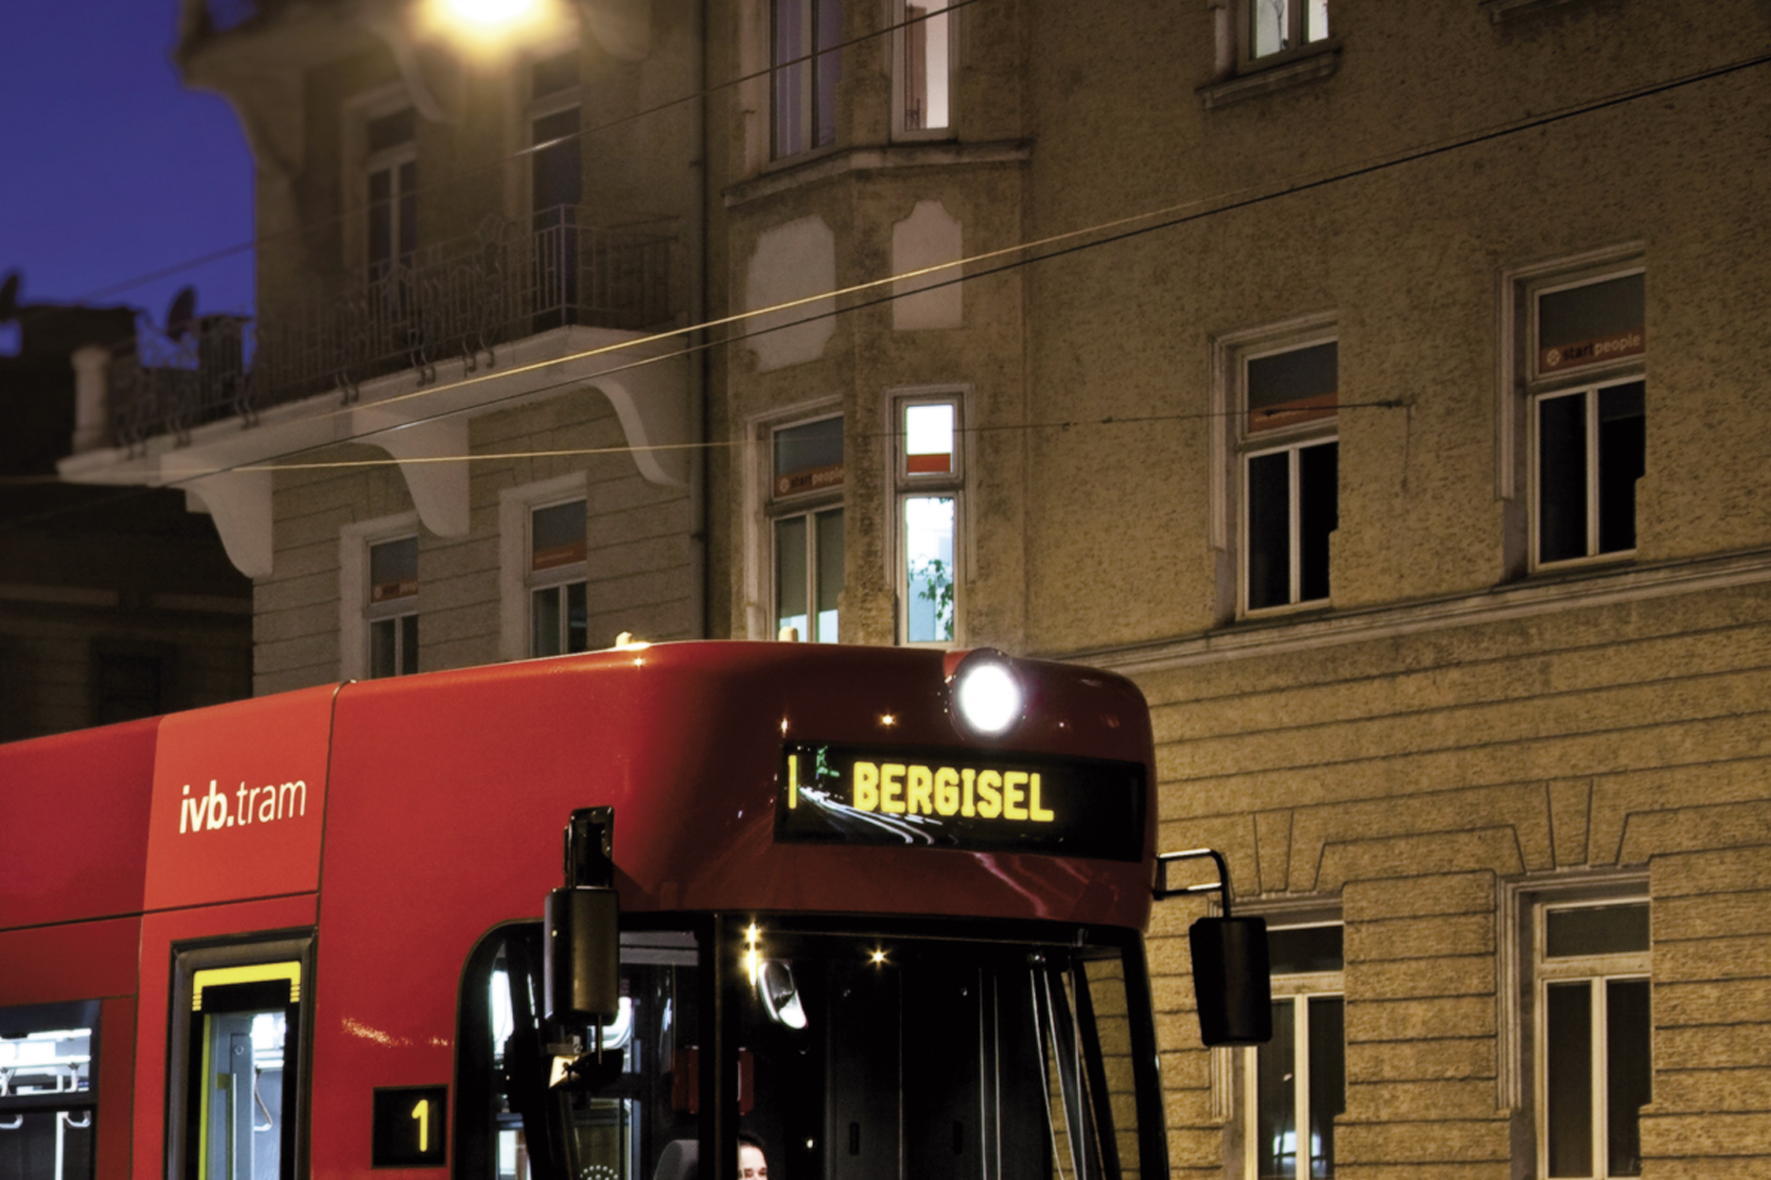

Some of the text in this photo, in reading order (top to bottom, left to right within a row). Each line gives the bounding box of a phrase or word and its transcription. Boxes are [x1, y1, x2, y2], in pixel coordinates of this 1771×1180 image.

[179, 779, 306, 834] ivb.tram
[853, 761, 1055, 823] BERGISEL
[411, 1098, 429, 1152] 1
